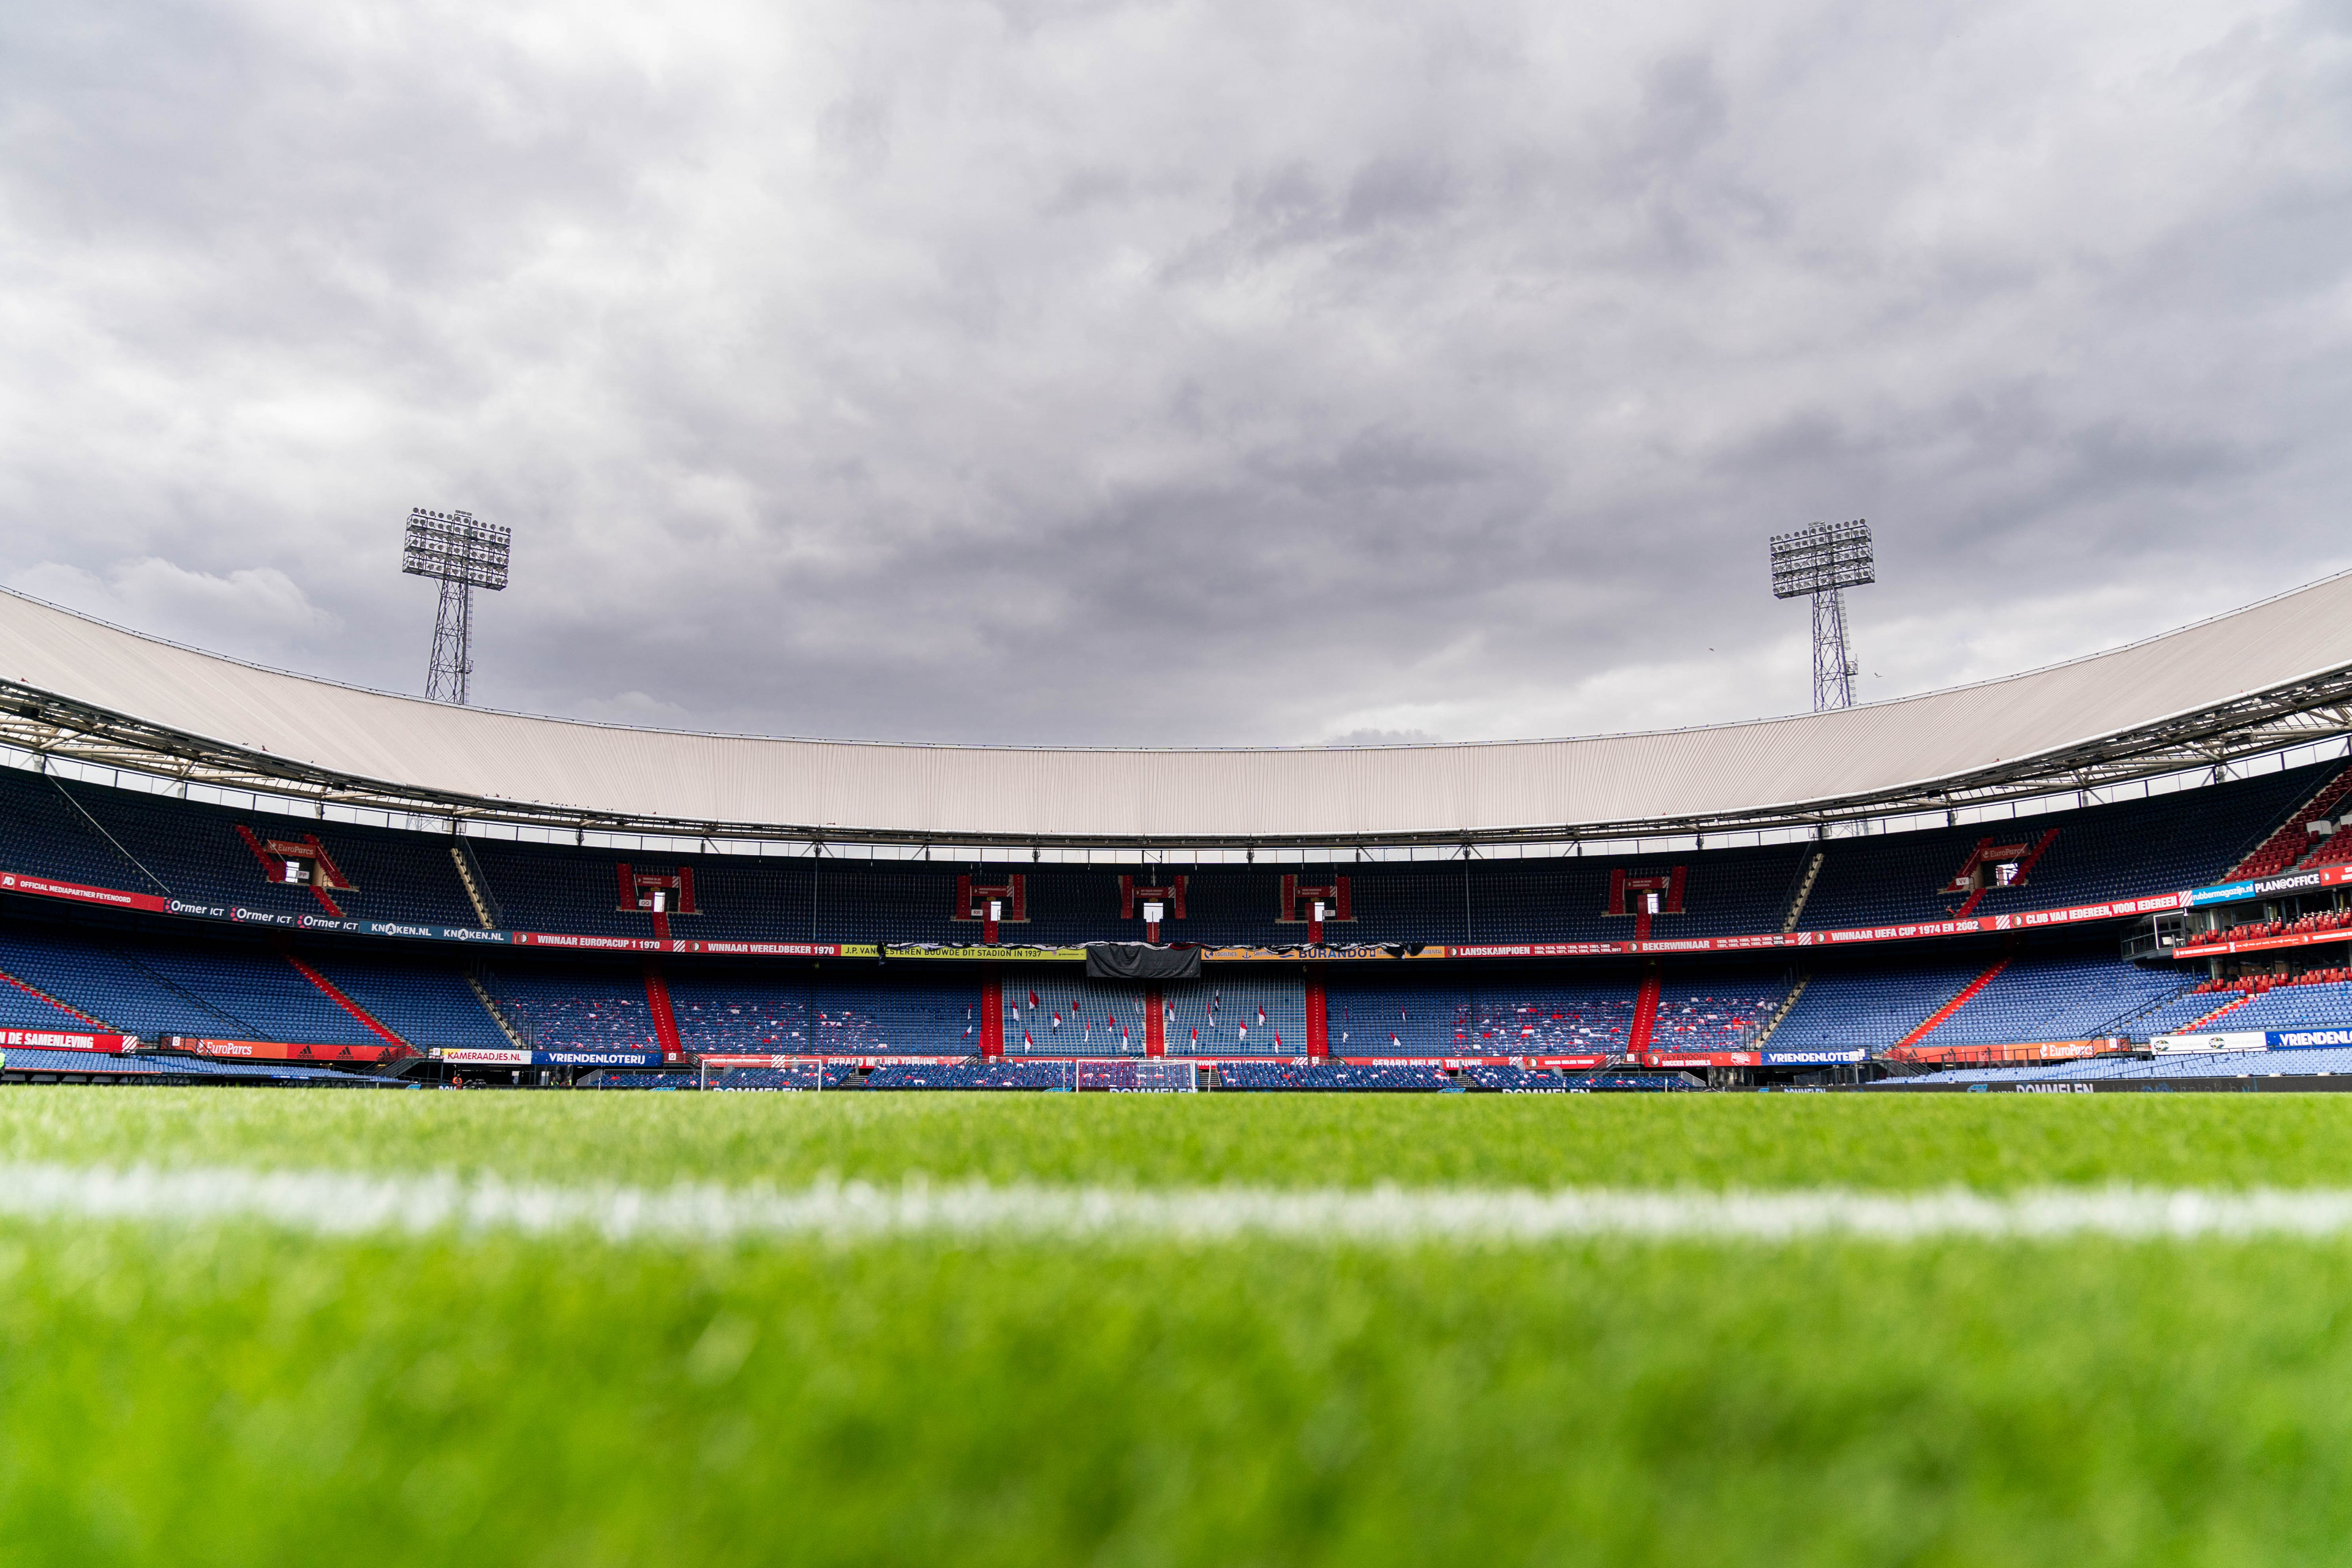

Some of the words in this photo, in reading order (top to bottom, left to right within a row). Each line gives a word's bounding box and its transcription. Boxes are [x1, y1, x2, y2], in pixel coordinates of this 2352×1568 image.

[278, 843, 314, 855] EuroParcs
[1990, 848, 2025, 858] EuroParcs
[2, 876, 15, 886] AD
[20, 881, 48, 891] OFFICIAL
[49, 885, 96, 899] MEDIAPARTNER
[96, 893, 131, 903] FEYENOORD
[2255, 874, 2320, 894] PLAN@OFFICE
[2193, 884, 2253, 902] rubbermagazijn.nl
[171, 900, 207, 914] Ormer
[210, 908, 224, 916] ICT
[237, 908, 274, 921] Ormer
[2026, 913, 2048, 924] CLUB
[2050, 911, 2067, 922] VAN
[2069, 905, 2112, 919] IEDEREEN,
[2113, 902, 2136, 914] VOOR
[2137, 895, 2178, 910] IEDEREEN
[303, 916, 340, 929] Ormer
[371, 923, 431, 936] KNAKEN.NL
[443, 929, 503, 941] KNAKEN.NL
[1831, 930, 1872, 941] WINNAAR
[1875, 928, 1897, 938] UEFA
[1899, 926, 1917, 937] CUP
[1918, 925, 1940, 935] 1974
[1942, 923, 1954, 932] EN
[1956, 921, 1978, 931] 2002
[538, 935, 578, 945] WINNAAR
[580, 938, 629, 948] EUROPACUP
[1643, 940, 1709, 951] BEKERWINNAAR
[708, 943, 748, 952] WINNAAR
[750, 944, 811, 954] WERELDBEKER
[813, 946, 834, 954] 1970
[1298, 949, 1367, 959] BURANDO
[1460, 946, 1530, 956] LANDSKAMPIOEN
[8, 1032, 23, 1044] DE
[24, 1033, 94, 1049] SAMENLEVING
[206, 1042, 252, 1055] EuroParcs
[2049, 1044, 2094, 1057] EuroParcs
[448, 1052, 521, 1061] KAMERAADJES.NL
[549, 1053, 646, 1065] VRIENDENLOTERIJ
[1768, 1053, 1849, 1063] VRIENDENLOTE
